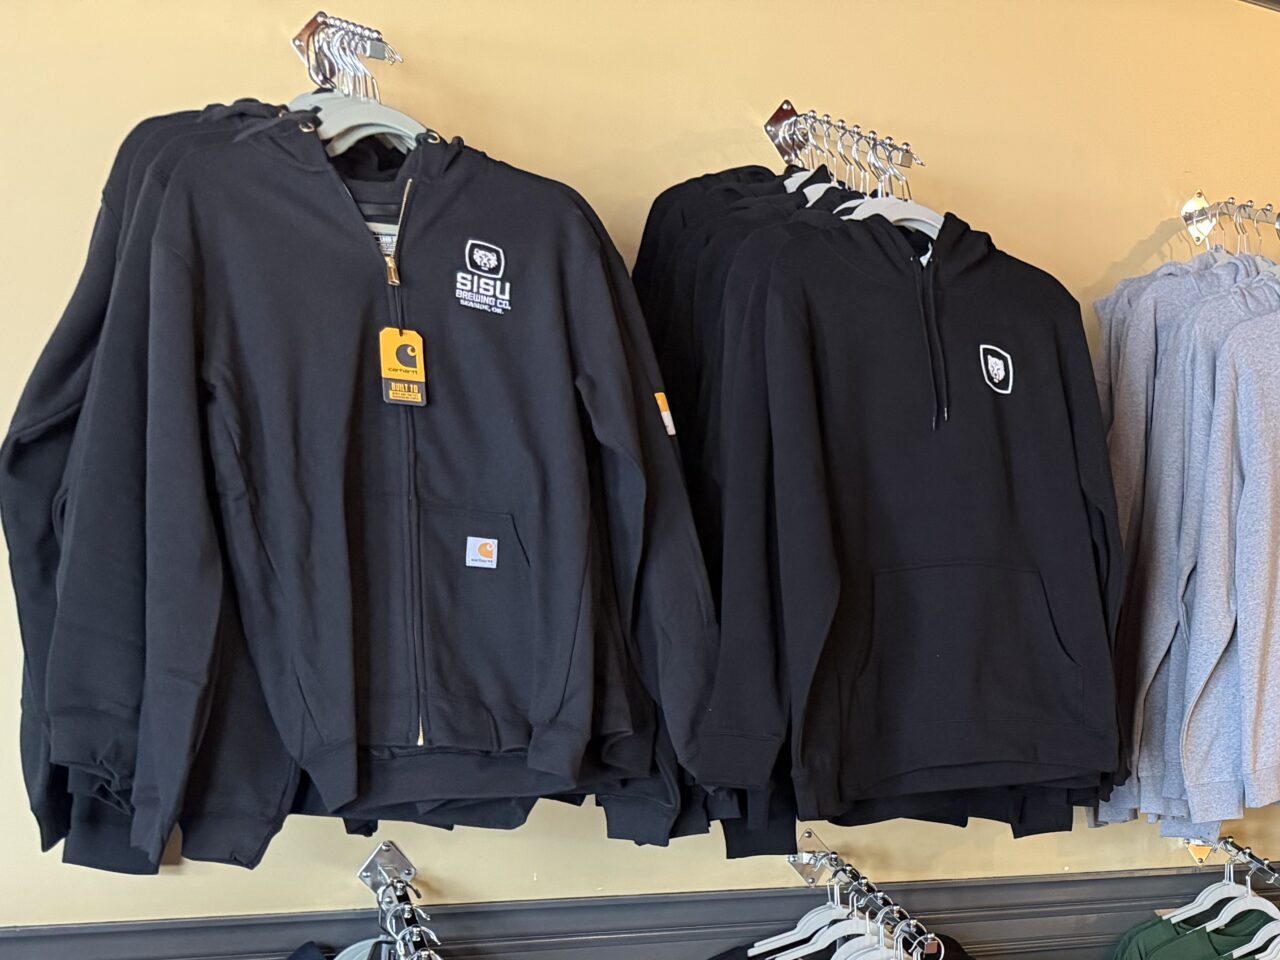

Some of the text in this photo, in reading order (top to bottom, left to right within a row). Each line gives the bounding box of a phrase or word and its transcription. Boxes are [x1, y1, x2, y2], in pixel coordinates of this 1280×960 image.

[456, 272, 511, 301] SISU
[455, 289, 512, 310] BREWING CO.
